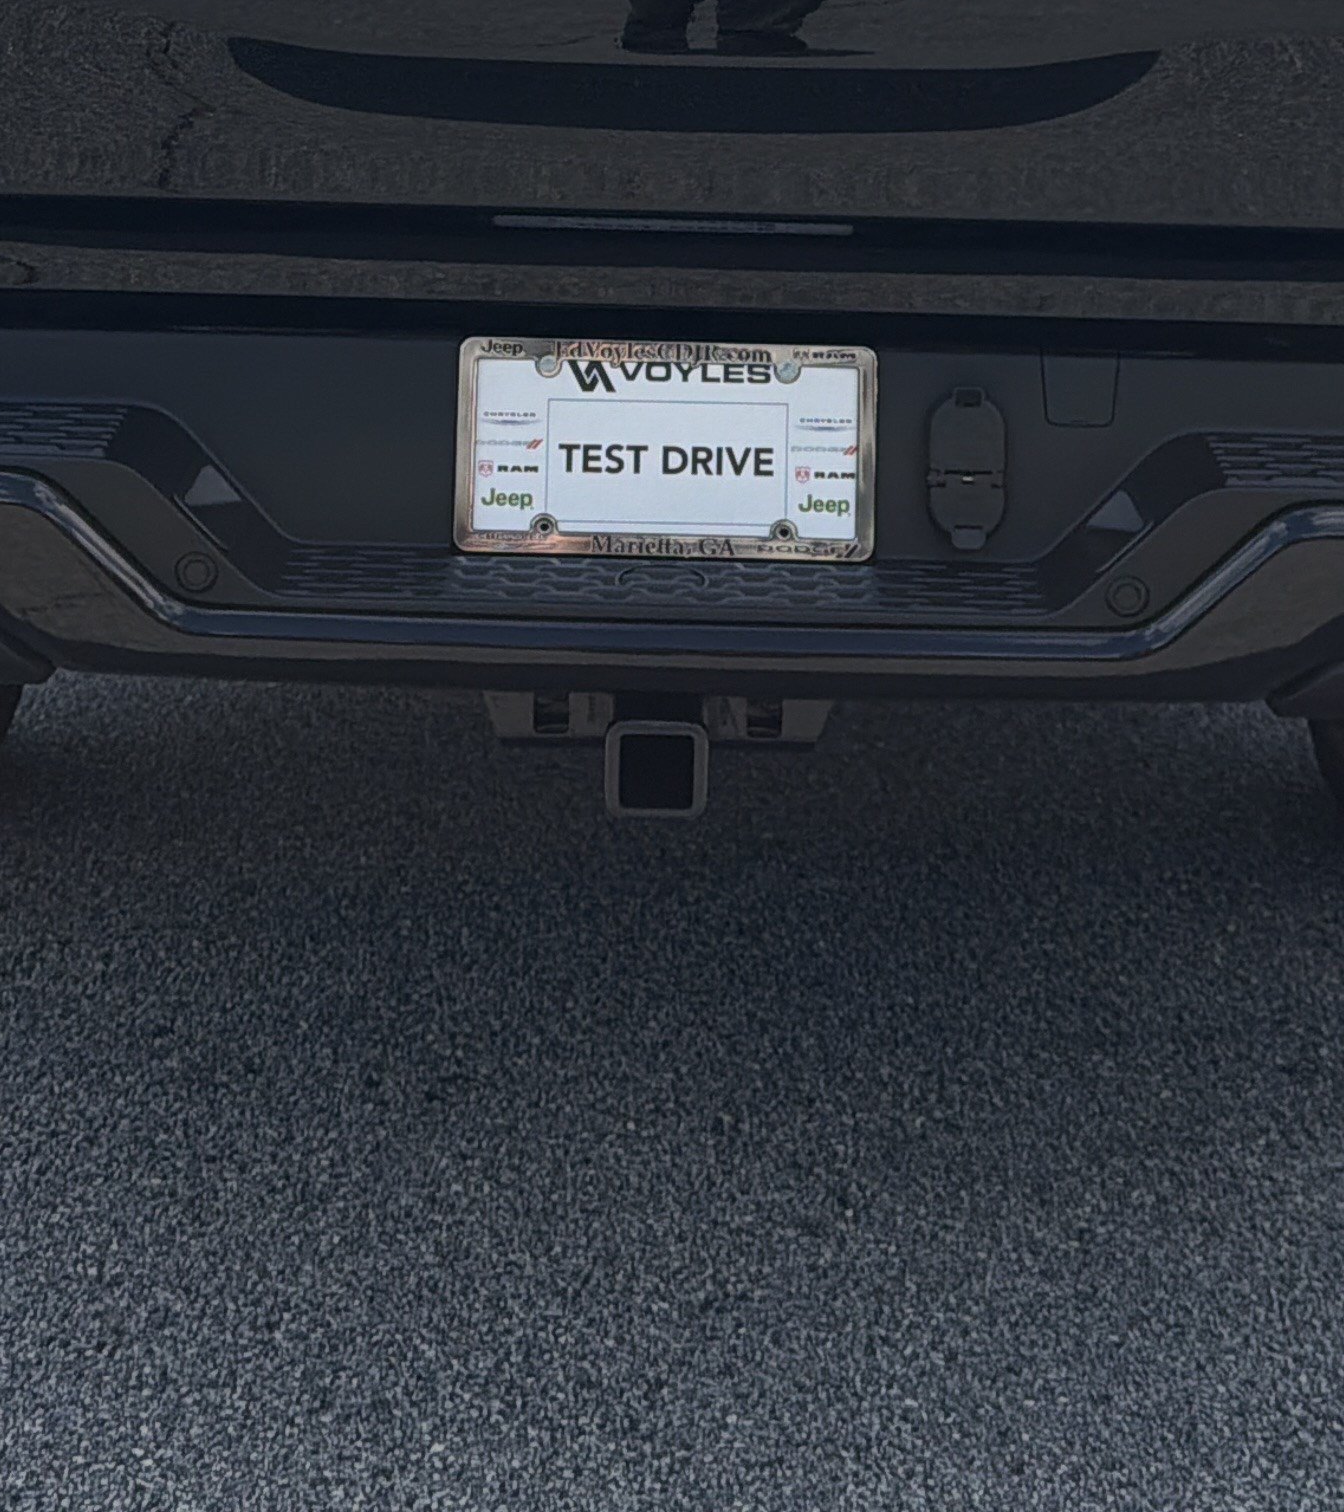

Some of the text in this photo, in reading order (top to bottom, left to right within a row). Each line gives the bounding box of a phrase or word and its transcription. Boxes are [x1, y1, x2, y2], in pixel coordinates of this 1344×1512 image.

[481, 340, 524, 356] Jeep
[620, 361, 771, 384] VOYLES
[497, 464, 540, 474] RAM
[558, 443, 774, 477] TEST DRIVE
[814, 471, 856, 480] RAM
[481, 487, 534, 510] Jeep
[798, 494, 851, 517] Jeep
[699, 538, 735, 556] GA
